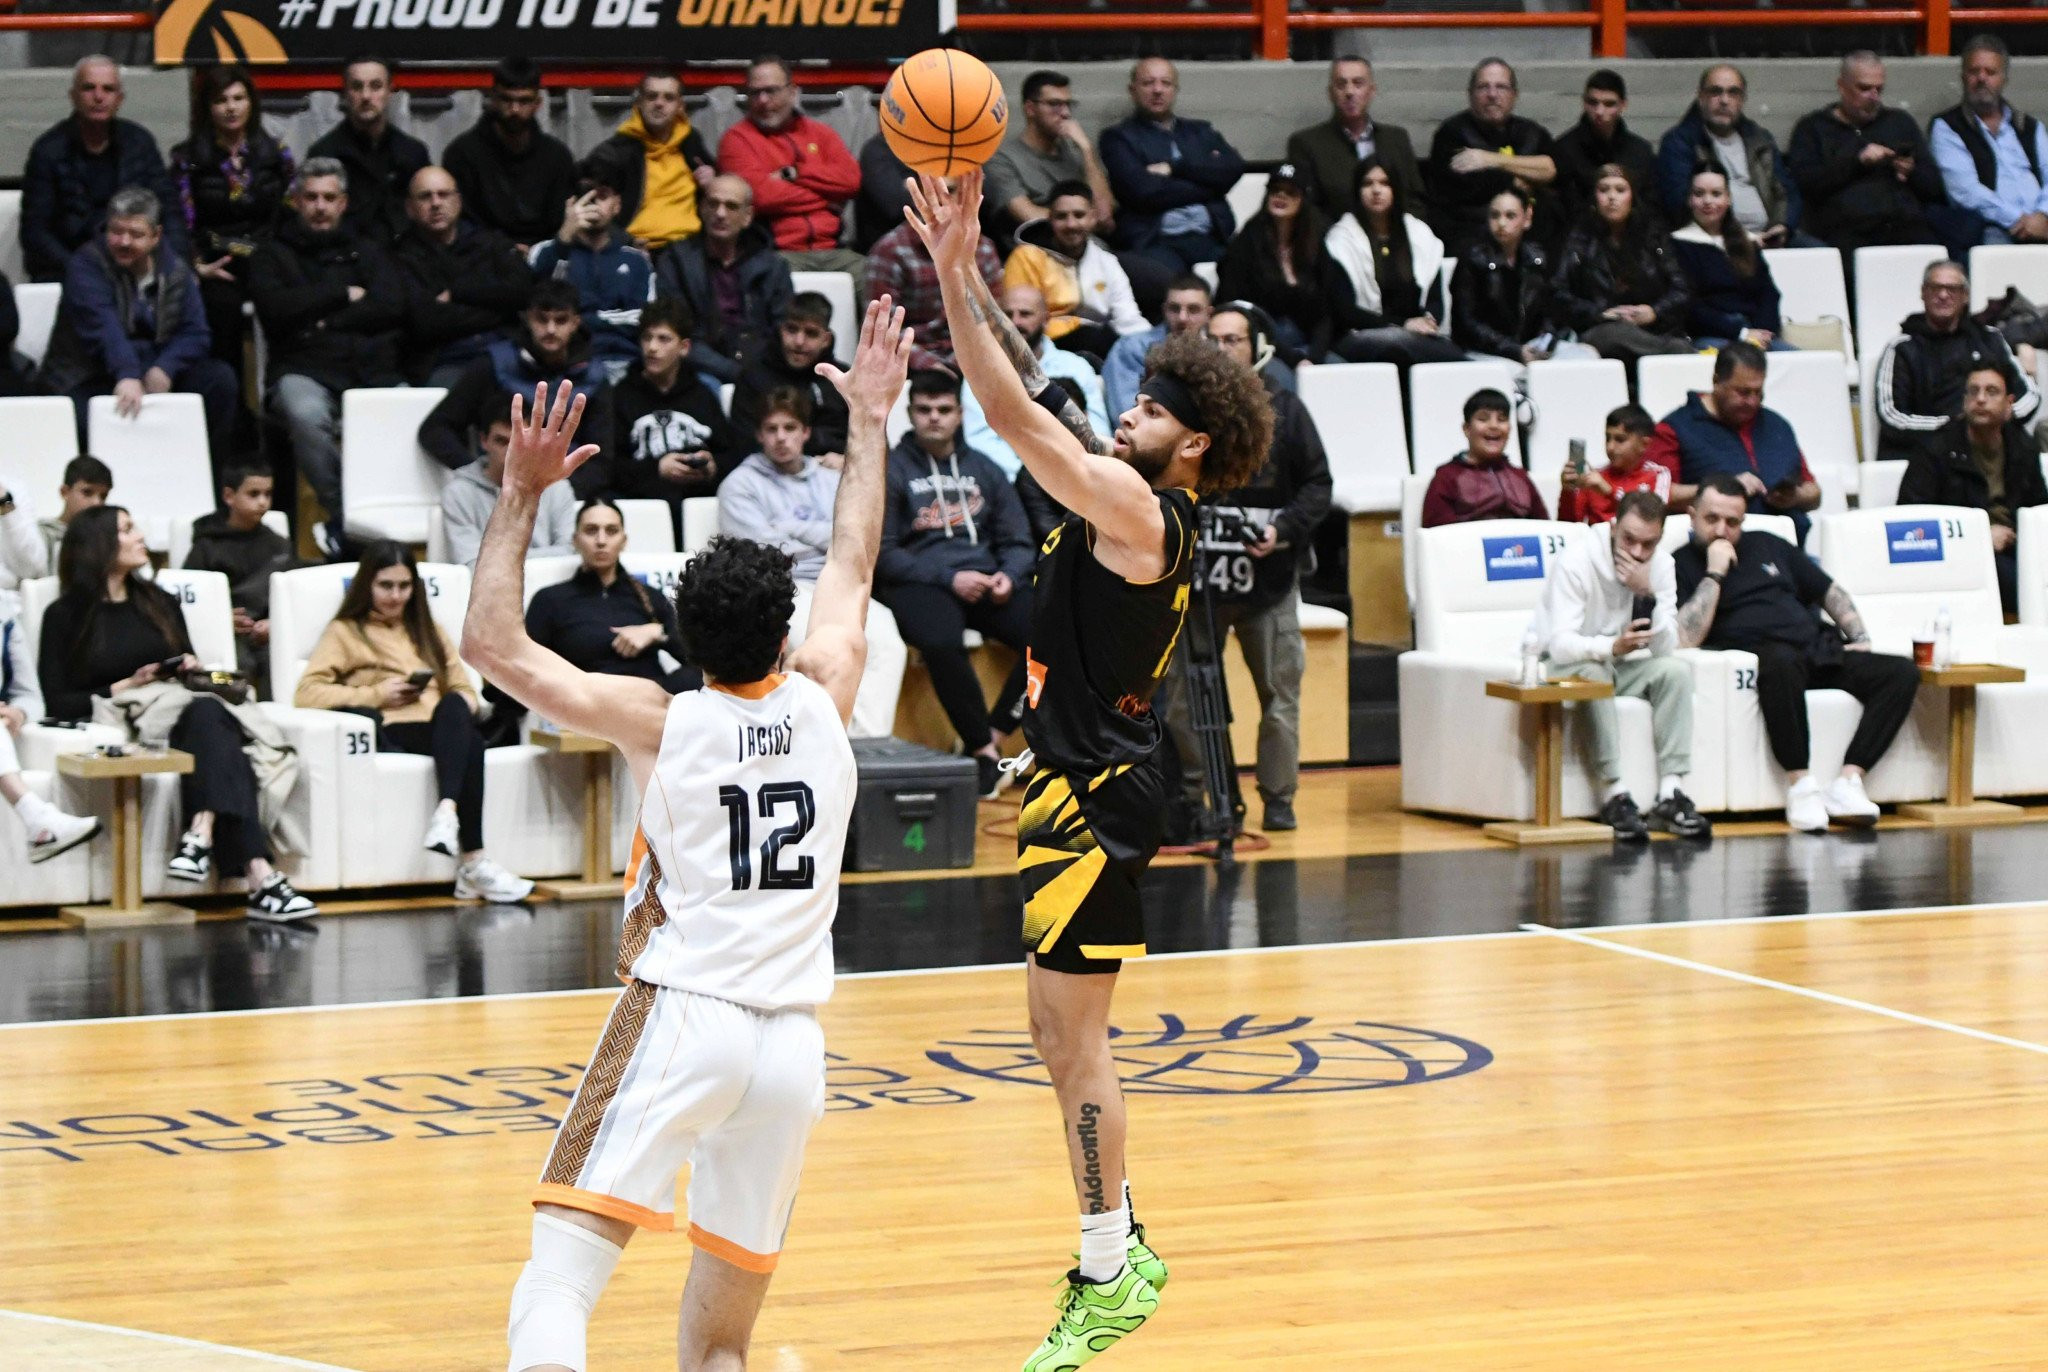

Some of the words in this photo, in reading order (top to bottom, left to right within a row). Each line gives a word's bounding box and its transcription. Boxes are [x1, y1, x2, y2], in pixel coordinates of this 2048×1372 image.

[515, 0, 581, 28] TO
[591, 0, 660, 28] BE
[1946, 519, 1963, 538] 31
[1736, 669, 1757, 690] 32
[346, 731, 370, 755] 35
[719, 780, 816, 891] 12
[903, 820, 926, 854] 4
